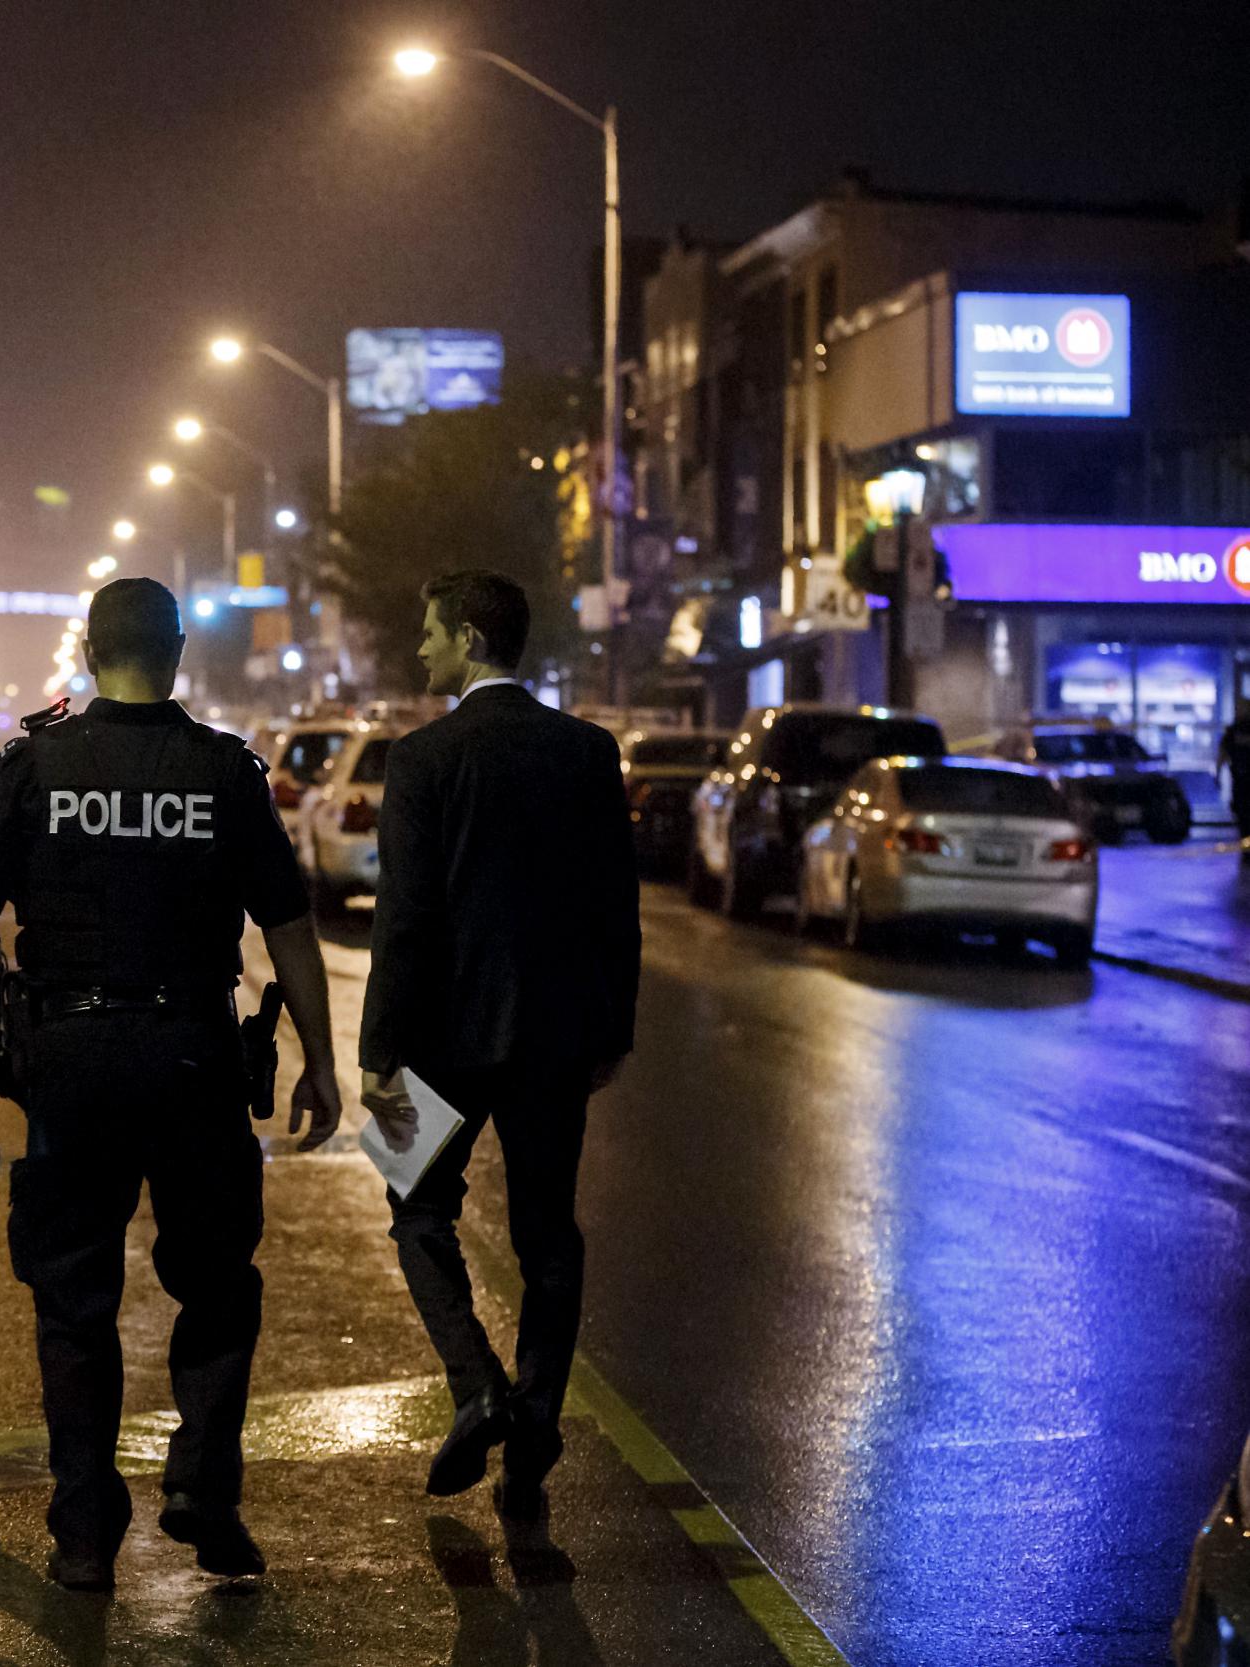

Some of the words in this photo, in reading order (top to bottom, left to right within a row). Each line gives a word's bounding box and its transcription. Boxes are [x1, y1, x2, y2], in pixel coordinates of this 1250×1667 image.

[972, 323, 1050, 353] BMO
[1138, 551, 1218, 583] BMO
[816, 590, 864, 618] 40
[48, 790, 214, 839] POLICE
